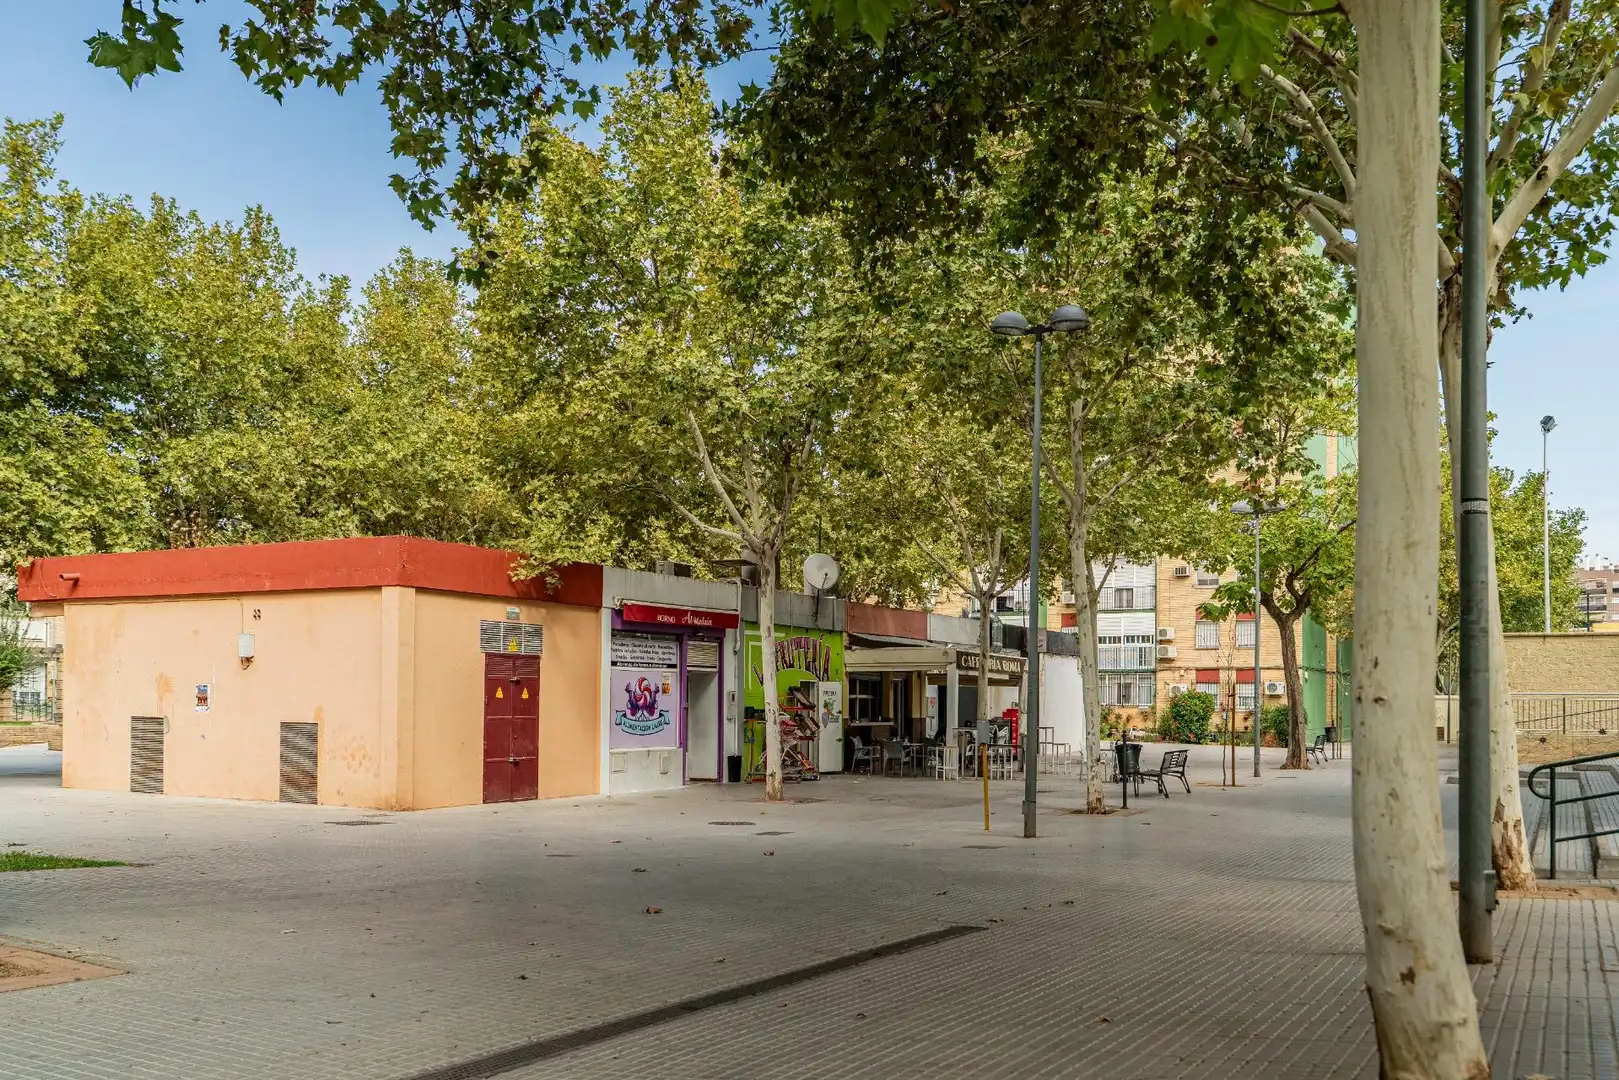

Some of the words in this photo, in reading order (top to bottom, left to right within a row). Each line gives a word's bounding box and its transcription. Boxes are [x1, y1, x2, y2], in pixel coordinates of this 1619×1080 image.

[657, 614, 676, 624] HORNO
[961, 655, 1002, 671] CAFERÍA
[1002, 660, 1021, 673] ROMA
